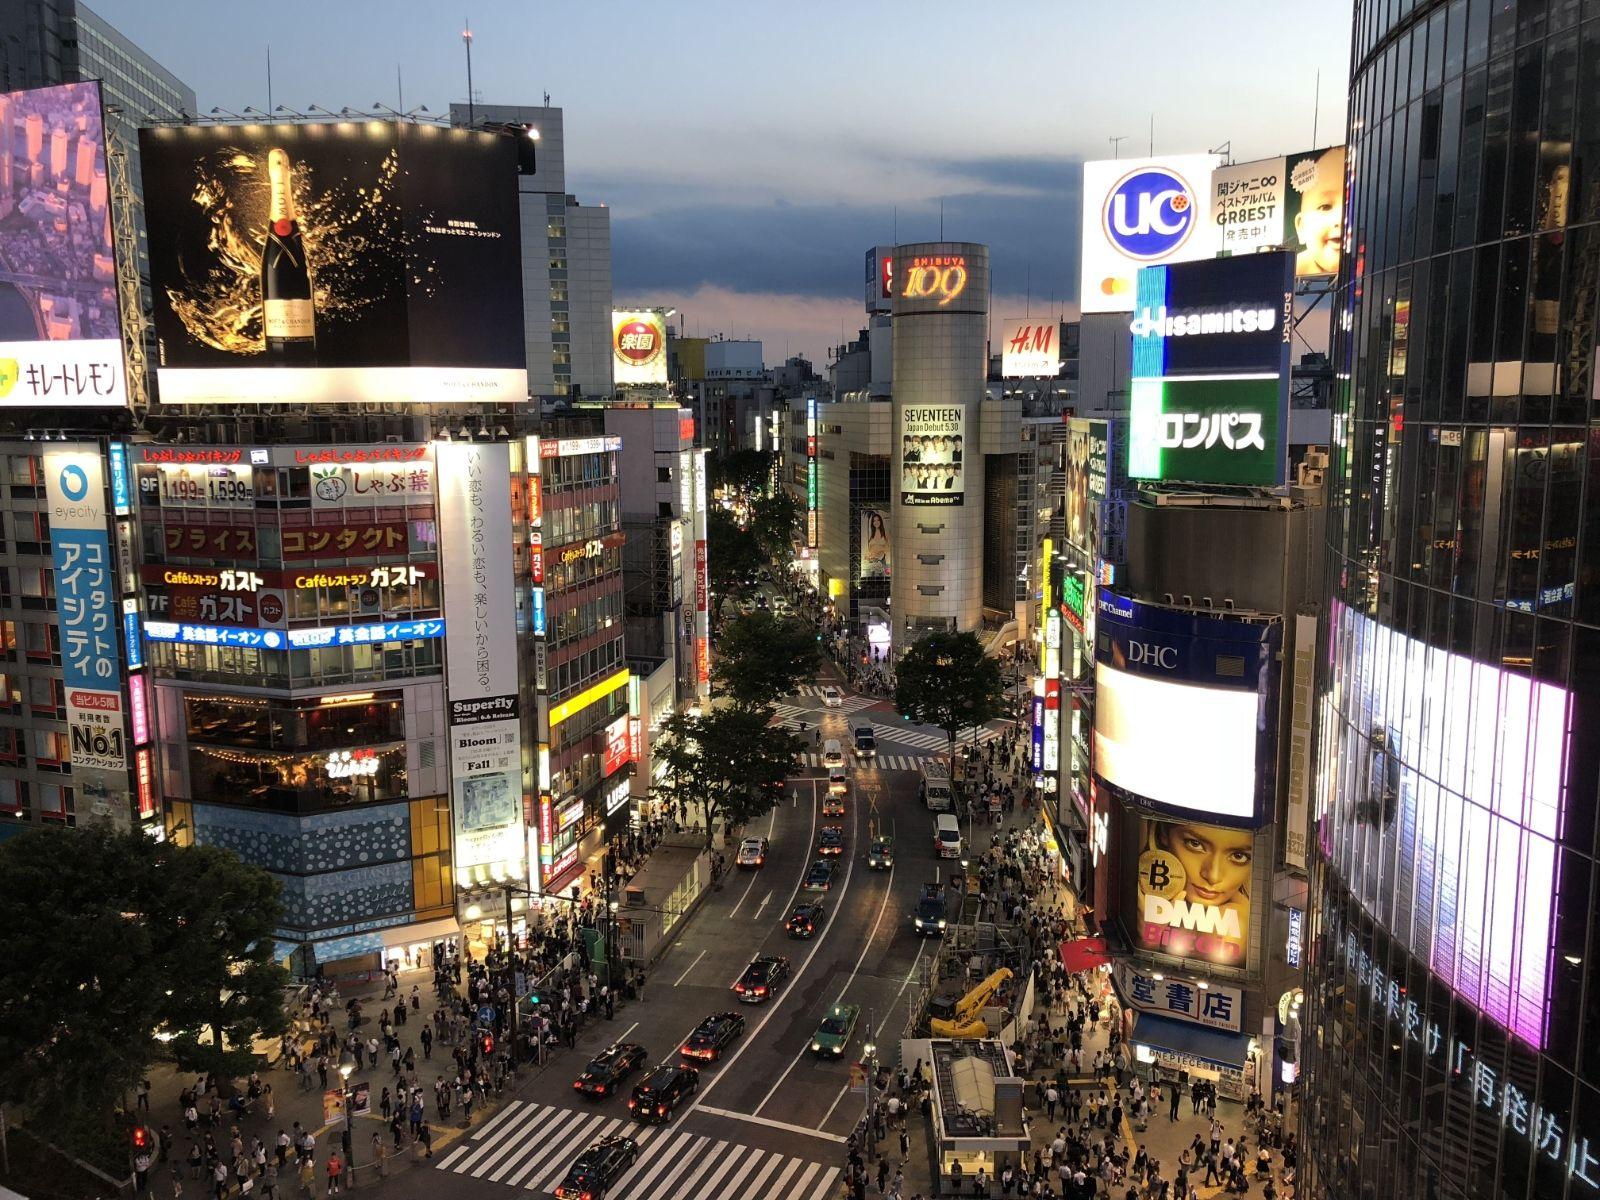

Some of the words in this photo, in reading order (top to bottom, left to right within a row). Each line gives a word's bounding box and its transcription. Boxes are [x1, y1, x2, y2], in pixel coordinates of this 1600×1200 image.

[1217, 175, 1277, 197] 関ジャニ∞
[1217, 191, 1276, 208] ベストアルバム
[1216, 205, 1276, 226] GR8EST
[914, 257, 965, 266] SHIBUYA
[902, 265, 967, 305] 109
[1130, 305, 1276, 338] Hisamitsu
[1283, 292, 1293, 343] サロンパス
[621, 333, 654, 350] 楽園
[1010, 325, 1053, 354] H&M
[26, 363, 116, 396] キレートレモン
[905, 408, 961, 421] SEVENTEEN
[907, 423, 924, 433] Japan
[924, 423, 944, 432] Debut
[945, 422, 959, 432] 5.30
[140, 477, 158, 492] 9F
[354, 468, 430, 495] しゃぶ葉
[55, 505, 98, 521] eyecity
[283, 526, 404, 553] コンタクト
[219, 569, 264, 592] ガスト
[370, 565, 426, 588] ガスト
[57, 542, 89, 677] アイシティ
[86, 542, 113, 678] コンタクトの
[148, 594, 169, 611] 7F
[199, 594, 253, 622] ガスト
[262, 606, 281, 615] ガスト
[1109, 603, 1133, 619] Channel
[338, 620, 442, 644] 英会話イーオン
[1128, 640, 1178, 669] DHC
[76, 694, 116, 709] 当ビル5階
[453, 697, 514, 713] Superfly
[70, 723, 124, 759] No.1
[72, 755, 124, 769] コンタクトショップ
[606, 779, 630, 811] LUSH
[1144, 894, 1241, 939] DMM
